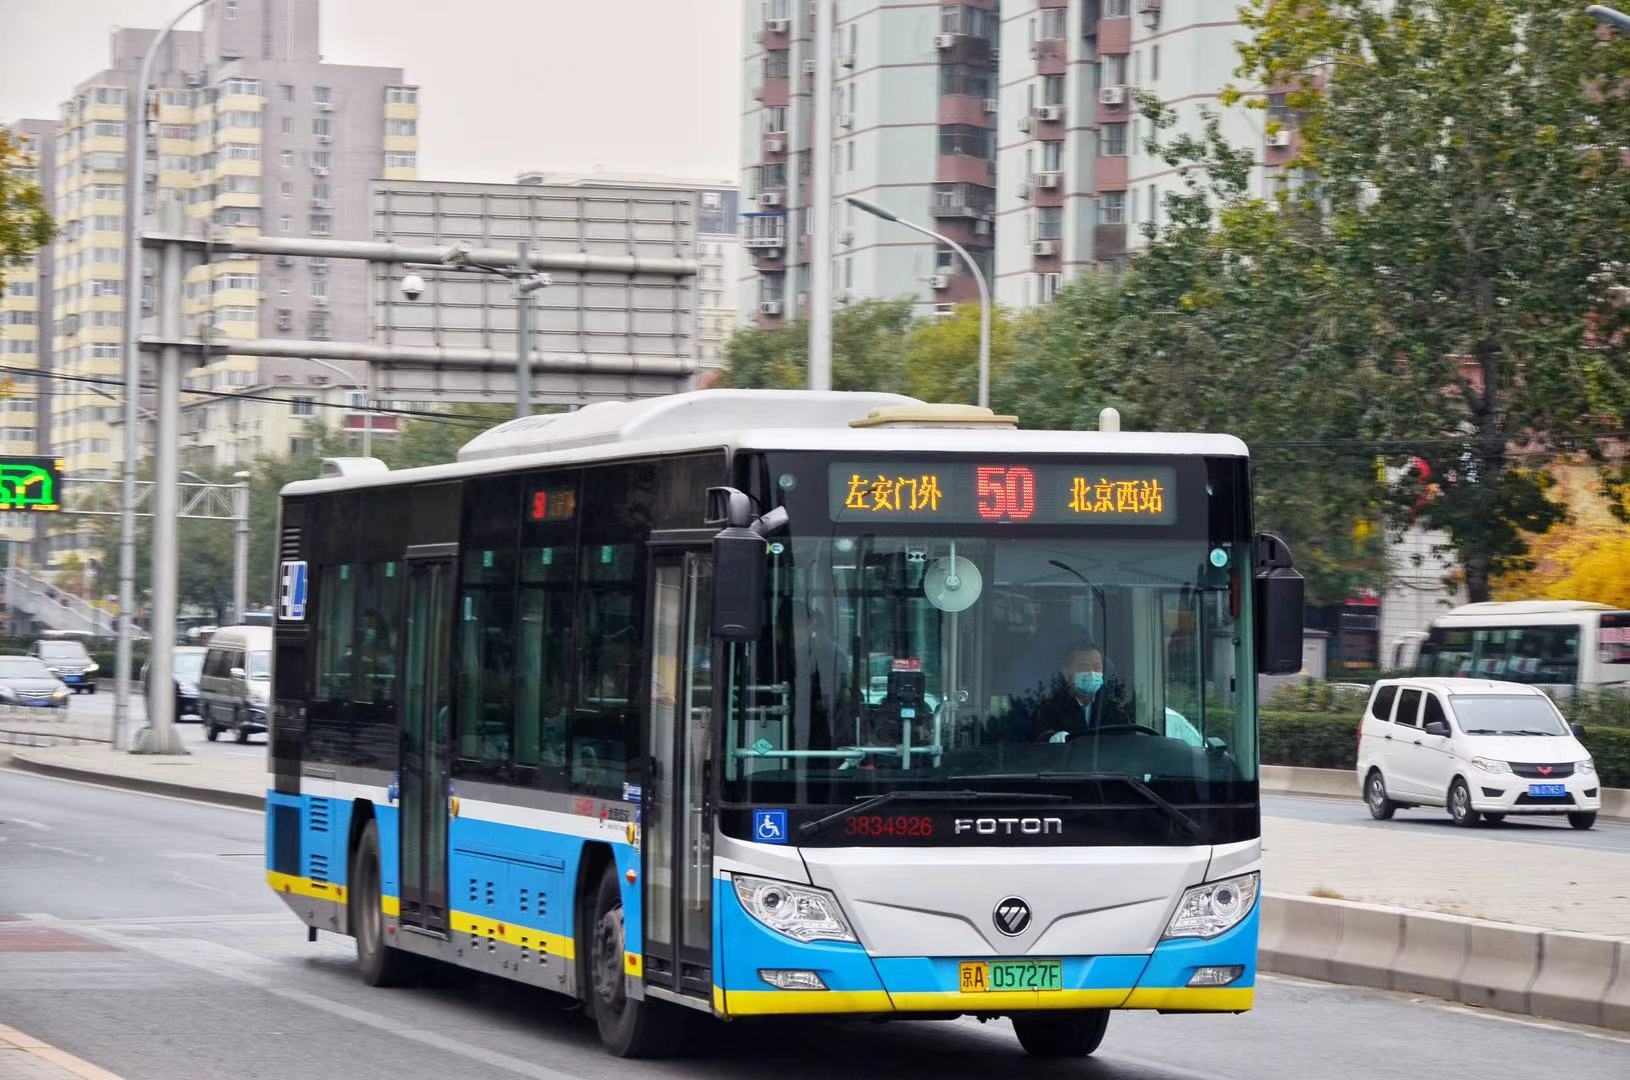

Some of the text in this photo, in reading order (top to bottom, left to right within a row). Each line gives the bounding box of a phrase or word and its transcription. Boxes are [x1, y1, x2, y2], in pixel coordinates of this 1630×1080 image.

[845, 466, 1164, 519] 左安门外 50 北京西站
[844, 816, 933, 837] 3834926
[954, 818, 1063, 834] FOTON
